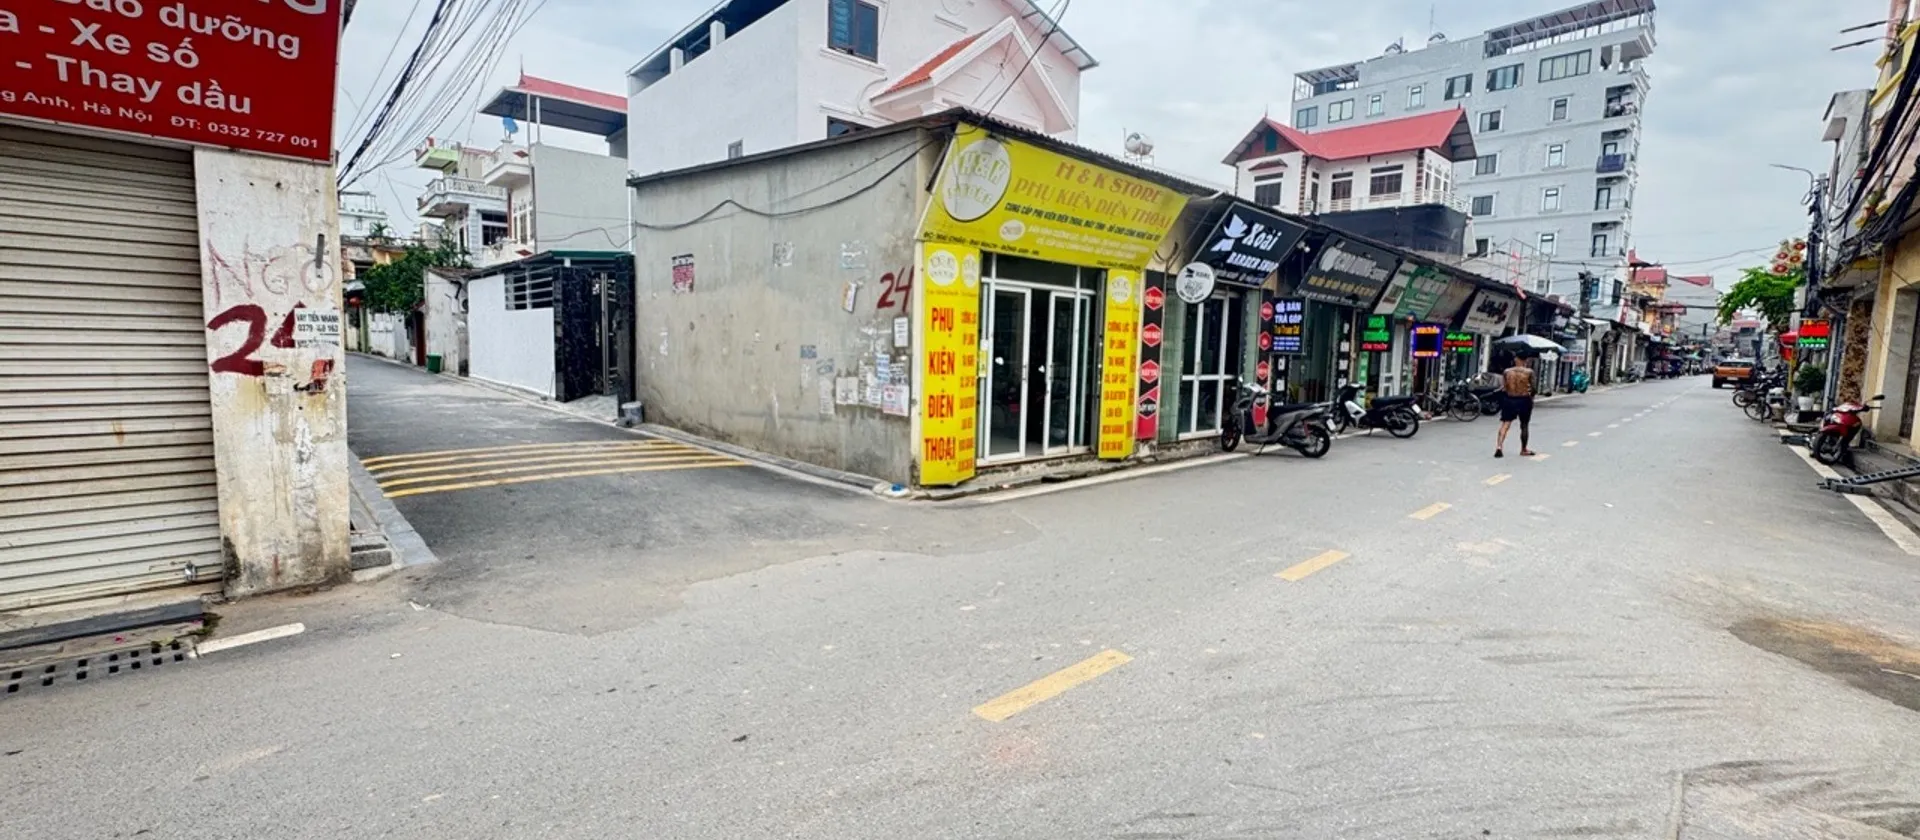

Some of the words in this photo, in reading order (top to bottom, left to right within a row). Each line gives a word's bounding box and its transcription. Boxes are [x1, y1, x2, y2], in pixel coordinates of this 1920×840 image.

[70, 18, 131, 55] Xe
[146, 37, 200, 69] số
[158, 2, 300, 60] dưỡng
[46, 53, 162, 103] Thay
[176, 79, 251, 114] dầu
[22, 91, 76, 111] Anh,
[83, 100, 112, 117] Hà
[118, 105, 153, 122] Nội
[170, 115, 201, 131] ĐT:
[208, 121, 250, 138] 0332
[255, 129, 287, 144] 727
[290, 135, 318, 149] 001
[1013, 177, 1054, 205] PHỤ
[1056, 189, 1092, 212] KIỆN
[1131, 208, 1172, 231] THOẠI
[1056, 161, 1076, 181] H
[1077, 168, 1091, 185] &
[1093, 173, 1109, 189] K
[1110, 178, 1164, 204] STORE
[877, 266, 913, 312] 24
[931, 307, 954, 338] PHỤ
[928, 346, 955, 380] KIỆN
[928, 389, 954, 423] ĐIỆN
[925, 437, 956, 466] THOẠI
